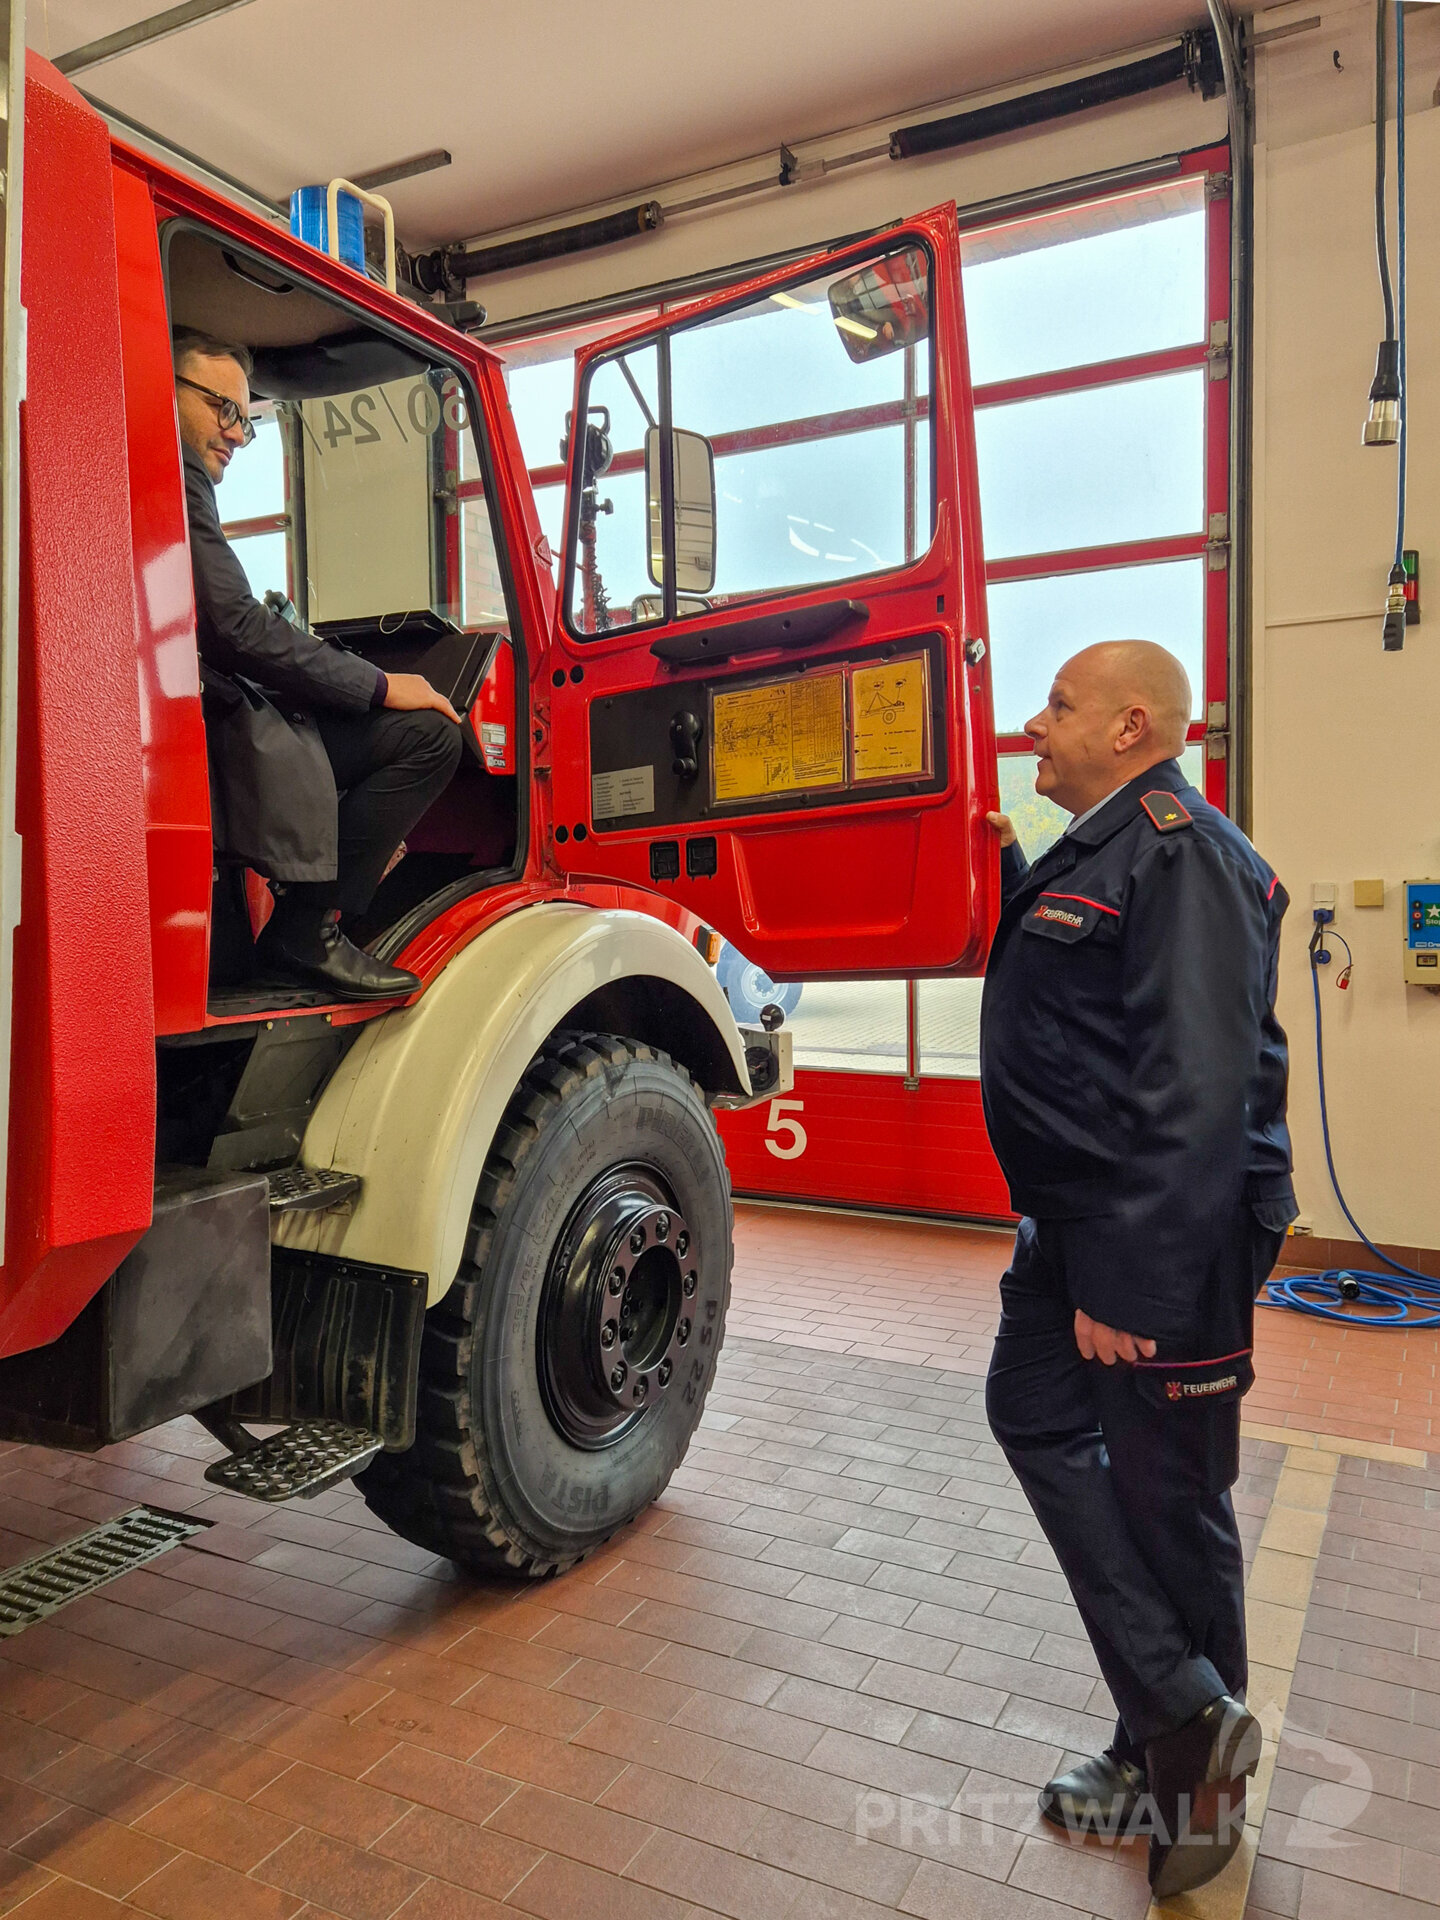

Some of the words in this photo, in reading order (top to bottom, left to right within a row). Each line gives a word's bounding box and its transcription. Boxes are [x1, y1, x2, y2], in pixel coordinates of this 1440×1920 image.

[1042, 908, 1084, 926] FEUERWEHR
[1425, 918, 1440, 927] Sto
[764, 1098, 808, 1161] 5
[700, 1299, 719, 1347] PS
[681, 1357, 705, 1406] 22
[1182, 1375, 1238, 1395] FEUERWEHR
[539, 1464, 610, 1515] PISTA
